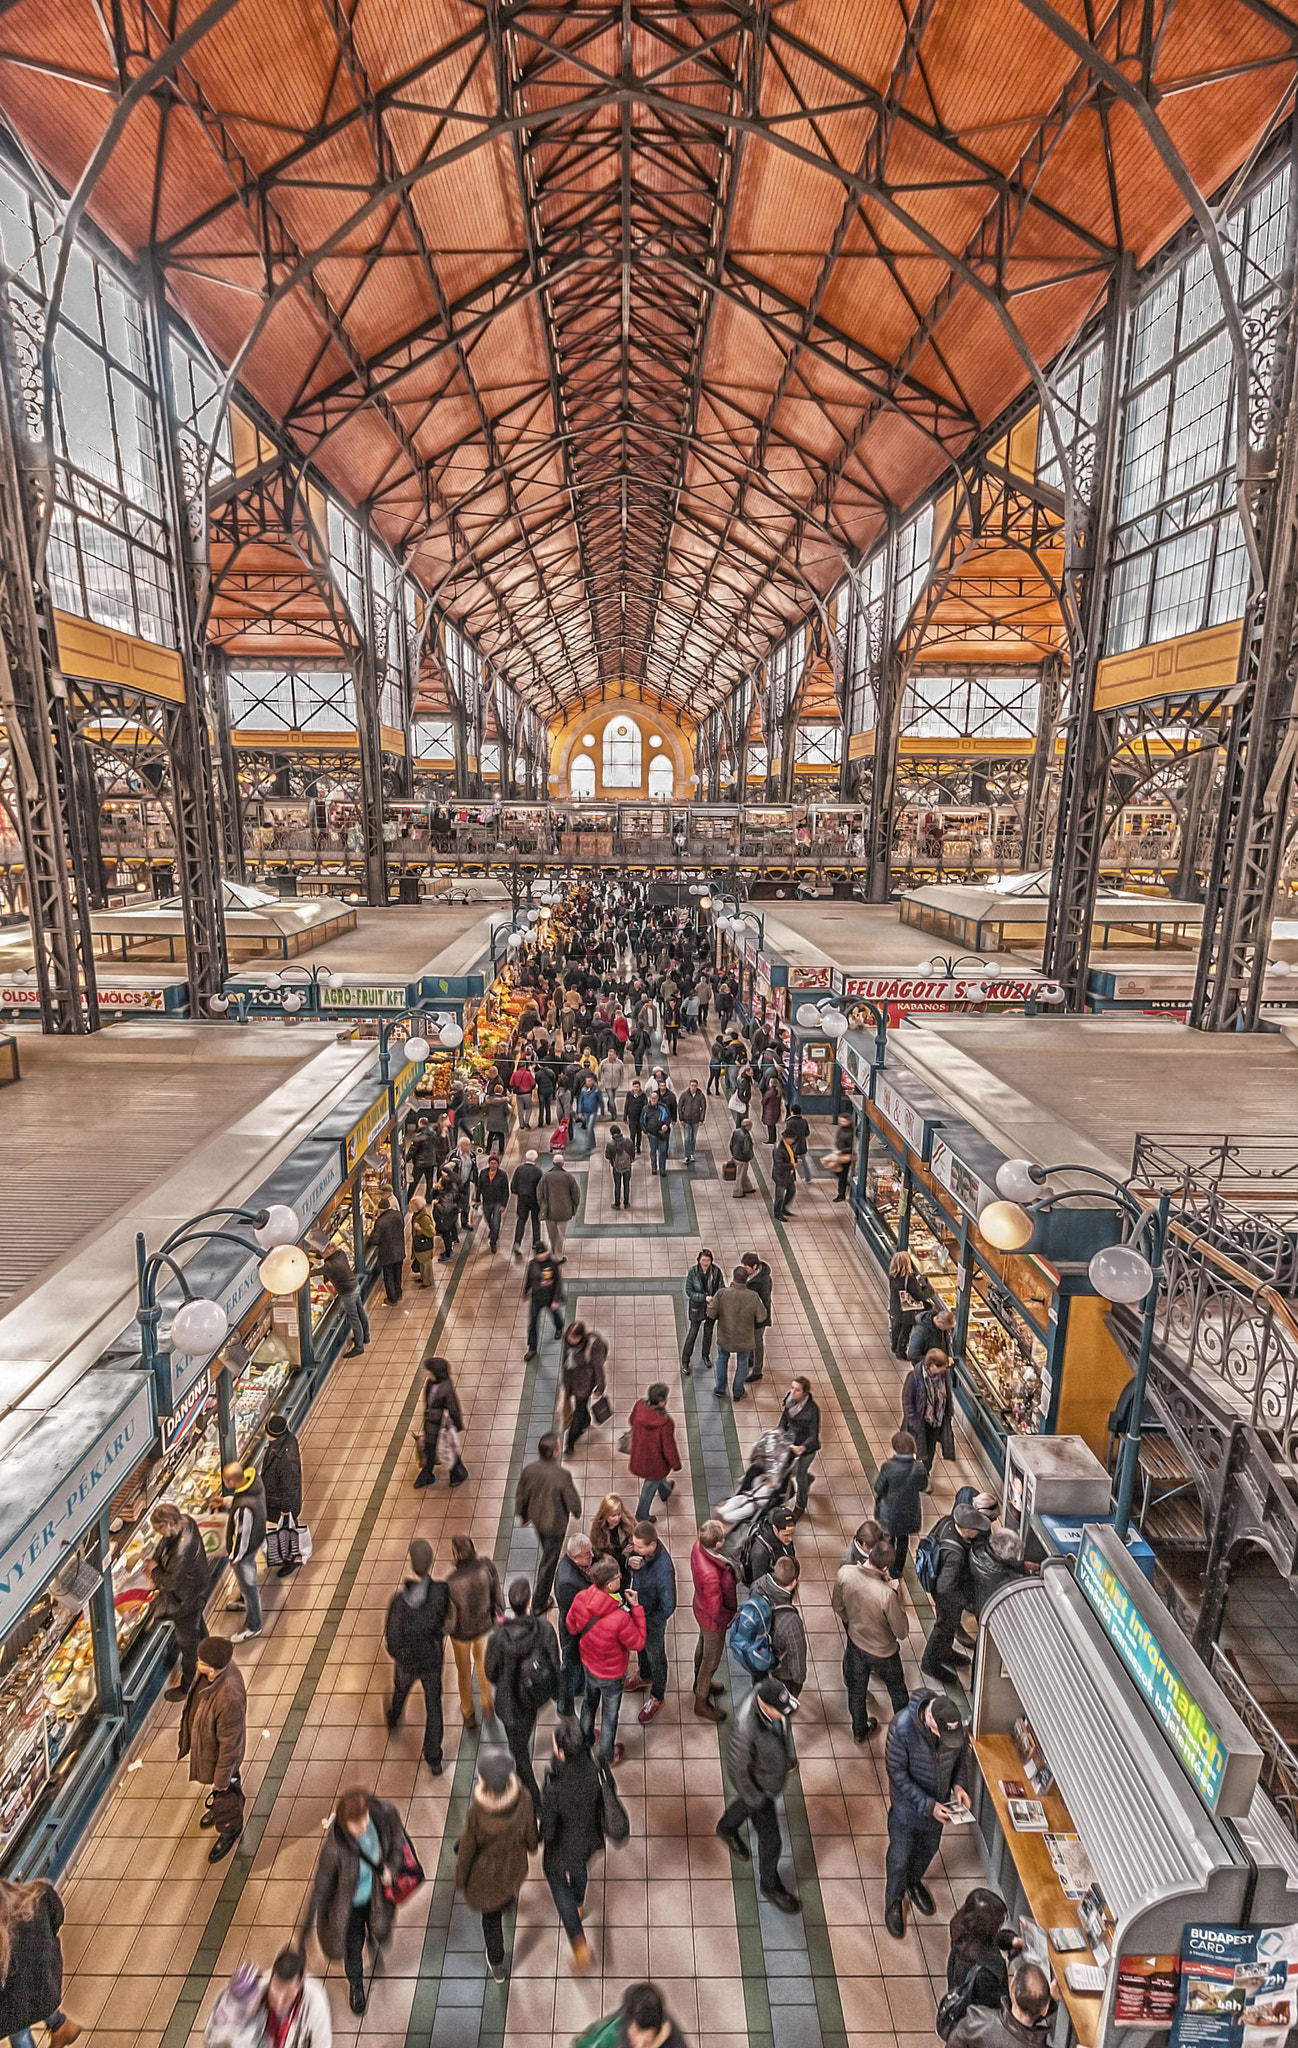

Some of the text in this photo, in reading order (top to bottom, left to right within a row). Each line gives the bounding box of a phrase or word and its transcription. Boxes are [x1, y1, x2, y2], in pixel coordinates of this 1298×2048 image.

[324, 987, 384, 1006] AGRO-FRUIT
[846, 979, 949, 999] FELVÁGOTT
[897, 1002, 946, 1012] KABANOS
[166, 1374, 207, 1439] DANONE
[1129, 1608, 1223, 1772] information
[1110, 1621, 1154, 1698] panaszok
[1154, 1691, 1215, 1799] bejelentése
[1181, 1718, 1218, 1783] brochures
[1189, 1939, 1226, 1954] CARD
[1190, 1928, 1255, 1946] BUDAPEST
